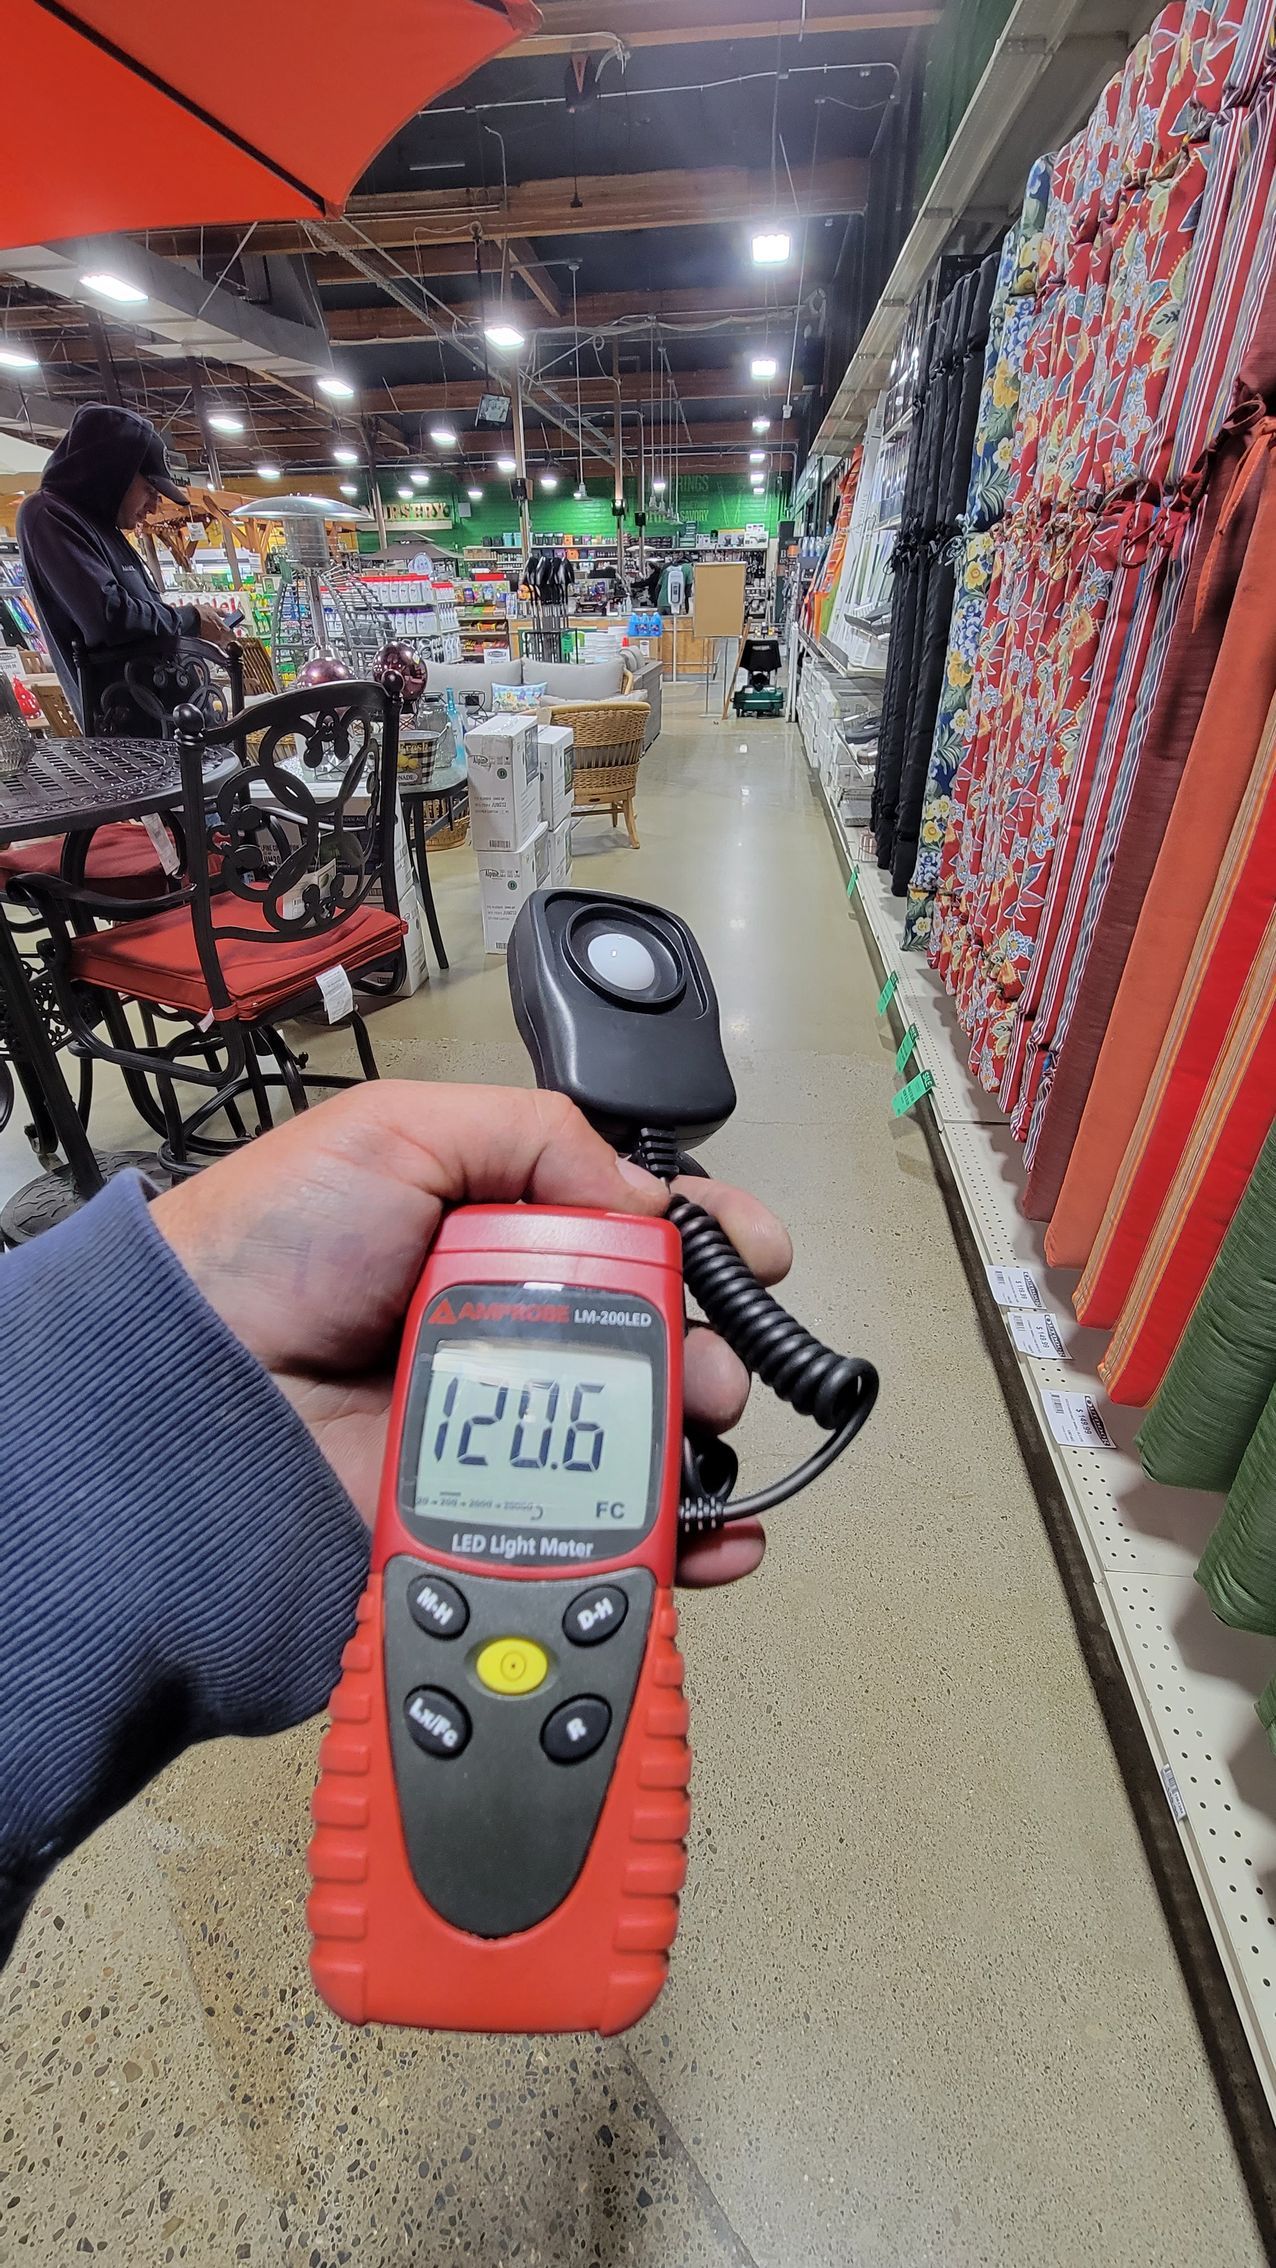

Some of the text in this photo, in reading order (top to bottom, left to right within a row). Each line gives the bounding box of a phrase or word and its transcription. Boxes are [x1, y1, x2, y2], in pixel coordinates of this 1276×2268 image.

[574, 1308, 652, 1328] LM-200LED
[433, 1376, 607, 1472] 120.6
[1084, 1395, 1111, 1447] OUTDOOR
[595, 1501, 625, 1520] FC
[452, 1534, 594, 1558] LED Light Meter
[416, 1586, 454, 1626] M-H
[576, 1597, 615, 1631] D-H
